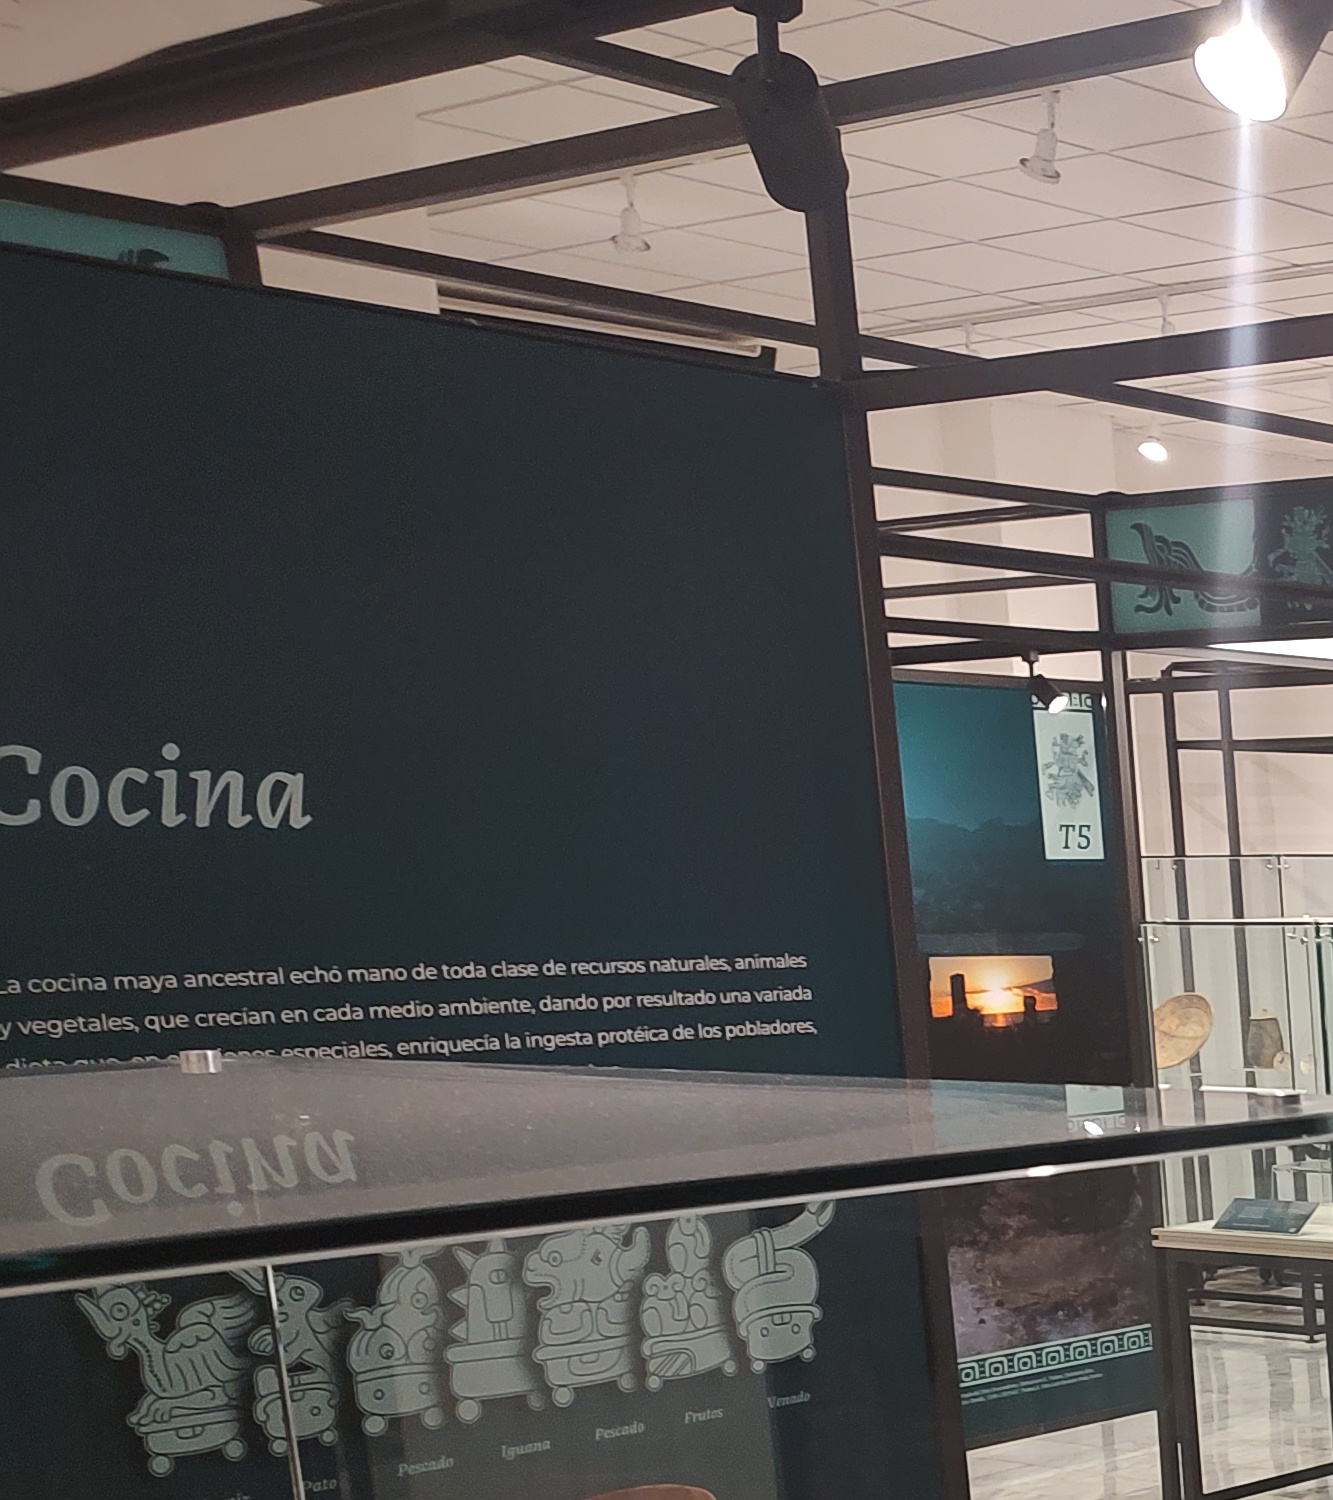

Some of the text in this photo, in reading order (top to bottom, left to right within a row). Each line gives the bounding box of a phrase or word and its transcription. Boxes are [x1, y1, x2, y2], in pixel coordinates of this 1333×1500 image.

[0, 742, 313, 830] Cocina
[1059, 824, 1091, 850] T5
[28, 973, 107, 994] cocina
[114, 974, 178, 994] maya
[184, 966, 285, 989] ancestral
[290, 965, 343, 985] echó
[347, 967, 408, 984] mano
[412, 963, 439, 981] de
[442, 960, 487, 980] toda
[491, 959, 539, 978] clase
[543, 958, 567, 977] de
[571, 958, 646, 976] recursos
[649, 954, 732, 974] naturales,
[734, 952, 808, 970] animales
[0, 985, 812, 1041] y vegetales, que crecían en cada medio ambiente, dando por resultado una variada
[397, 1033, 501, 1057] enriquecía
[505, 1031, 522, 1050] la
[525, 1028, 594, 1052] ingesta
[598, 1025, 669, 1048] protéica
[672, 1023, 695, 1041] de
[698, 1022, 723, 1040] los
[725, 1018, 818, 1041] pobladores,
[684, 1406, 724, 1424] Frutos
[595, 1420, 645, 1441] Pescado
[500, 1440, 551, 1461] Iguana
[397, 1455, 454, 1476] Pescado
